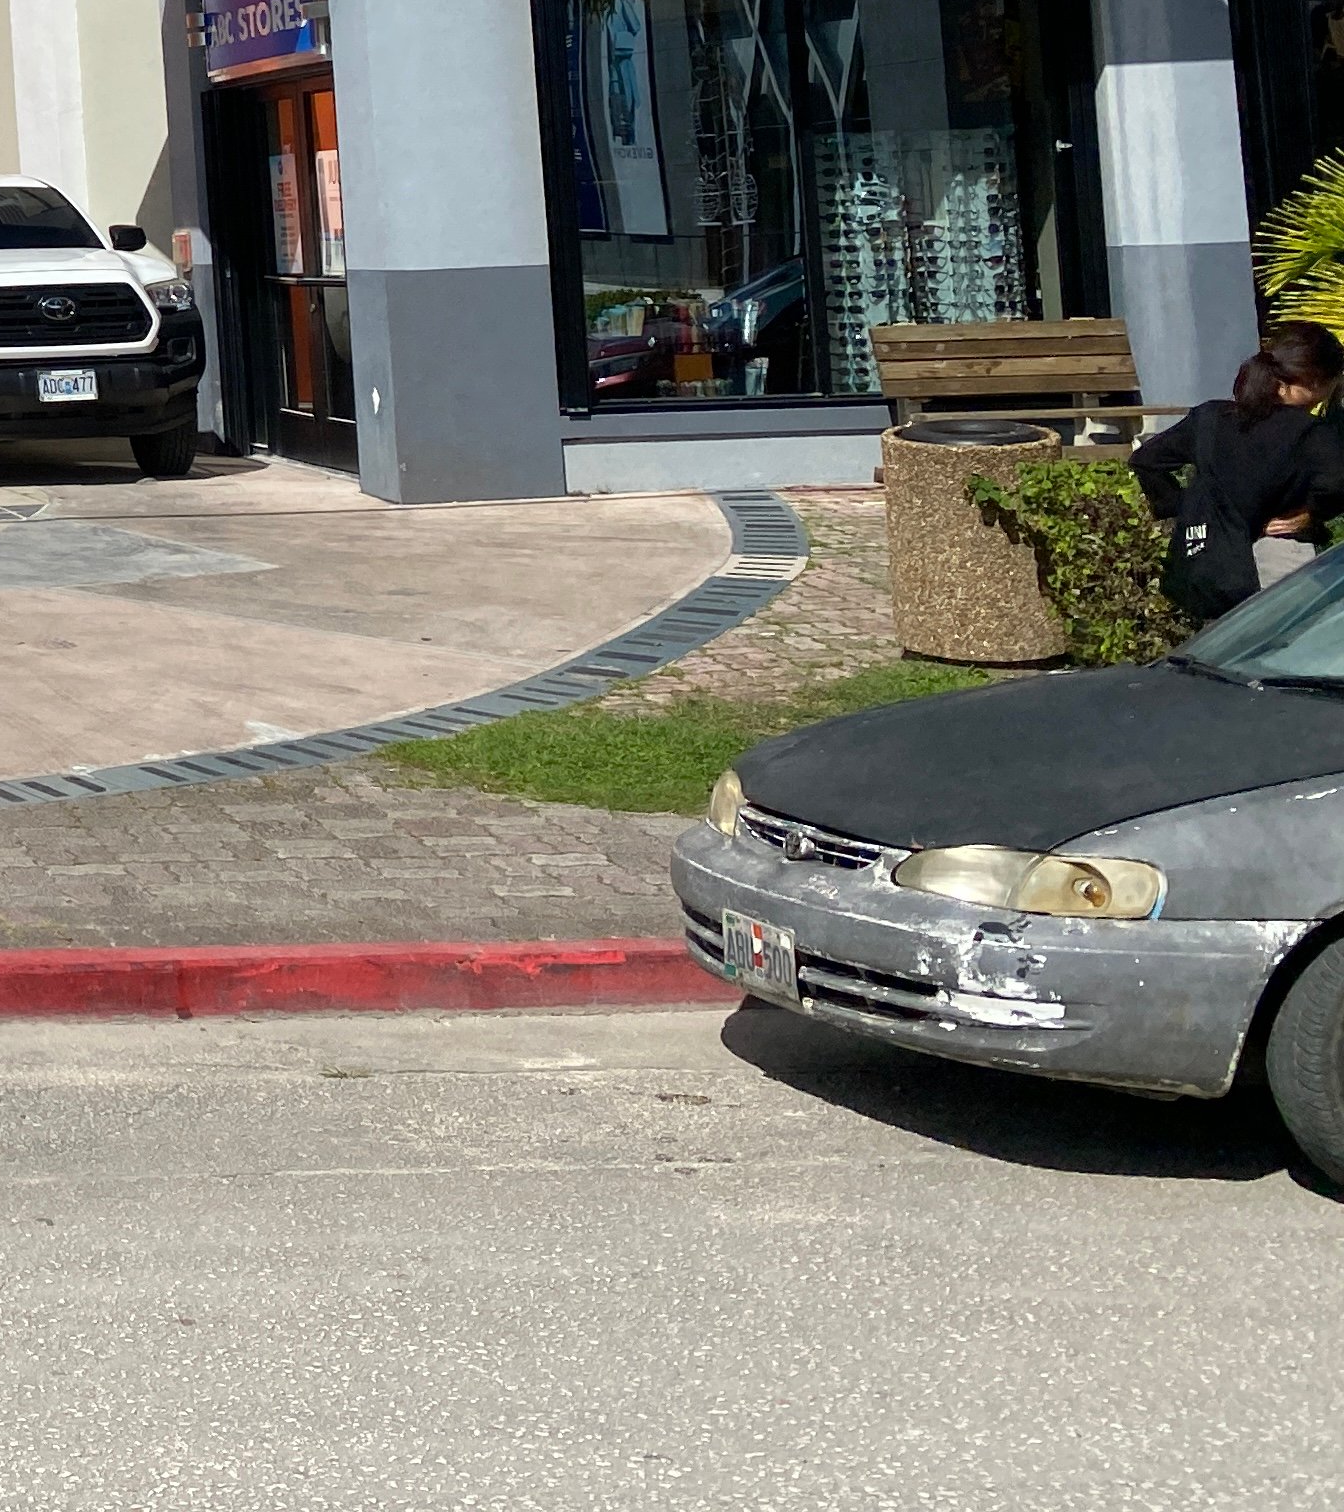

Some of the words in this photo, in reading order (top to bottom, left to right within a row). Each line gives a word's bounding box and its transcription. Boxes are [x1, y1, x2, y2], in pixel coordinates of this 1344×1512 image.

[208, 11, 234, 48] ABC
[73, 376, 94, 393] 477
[763, 941, 793, 987] 500
